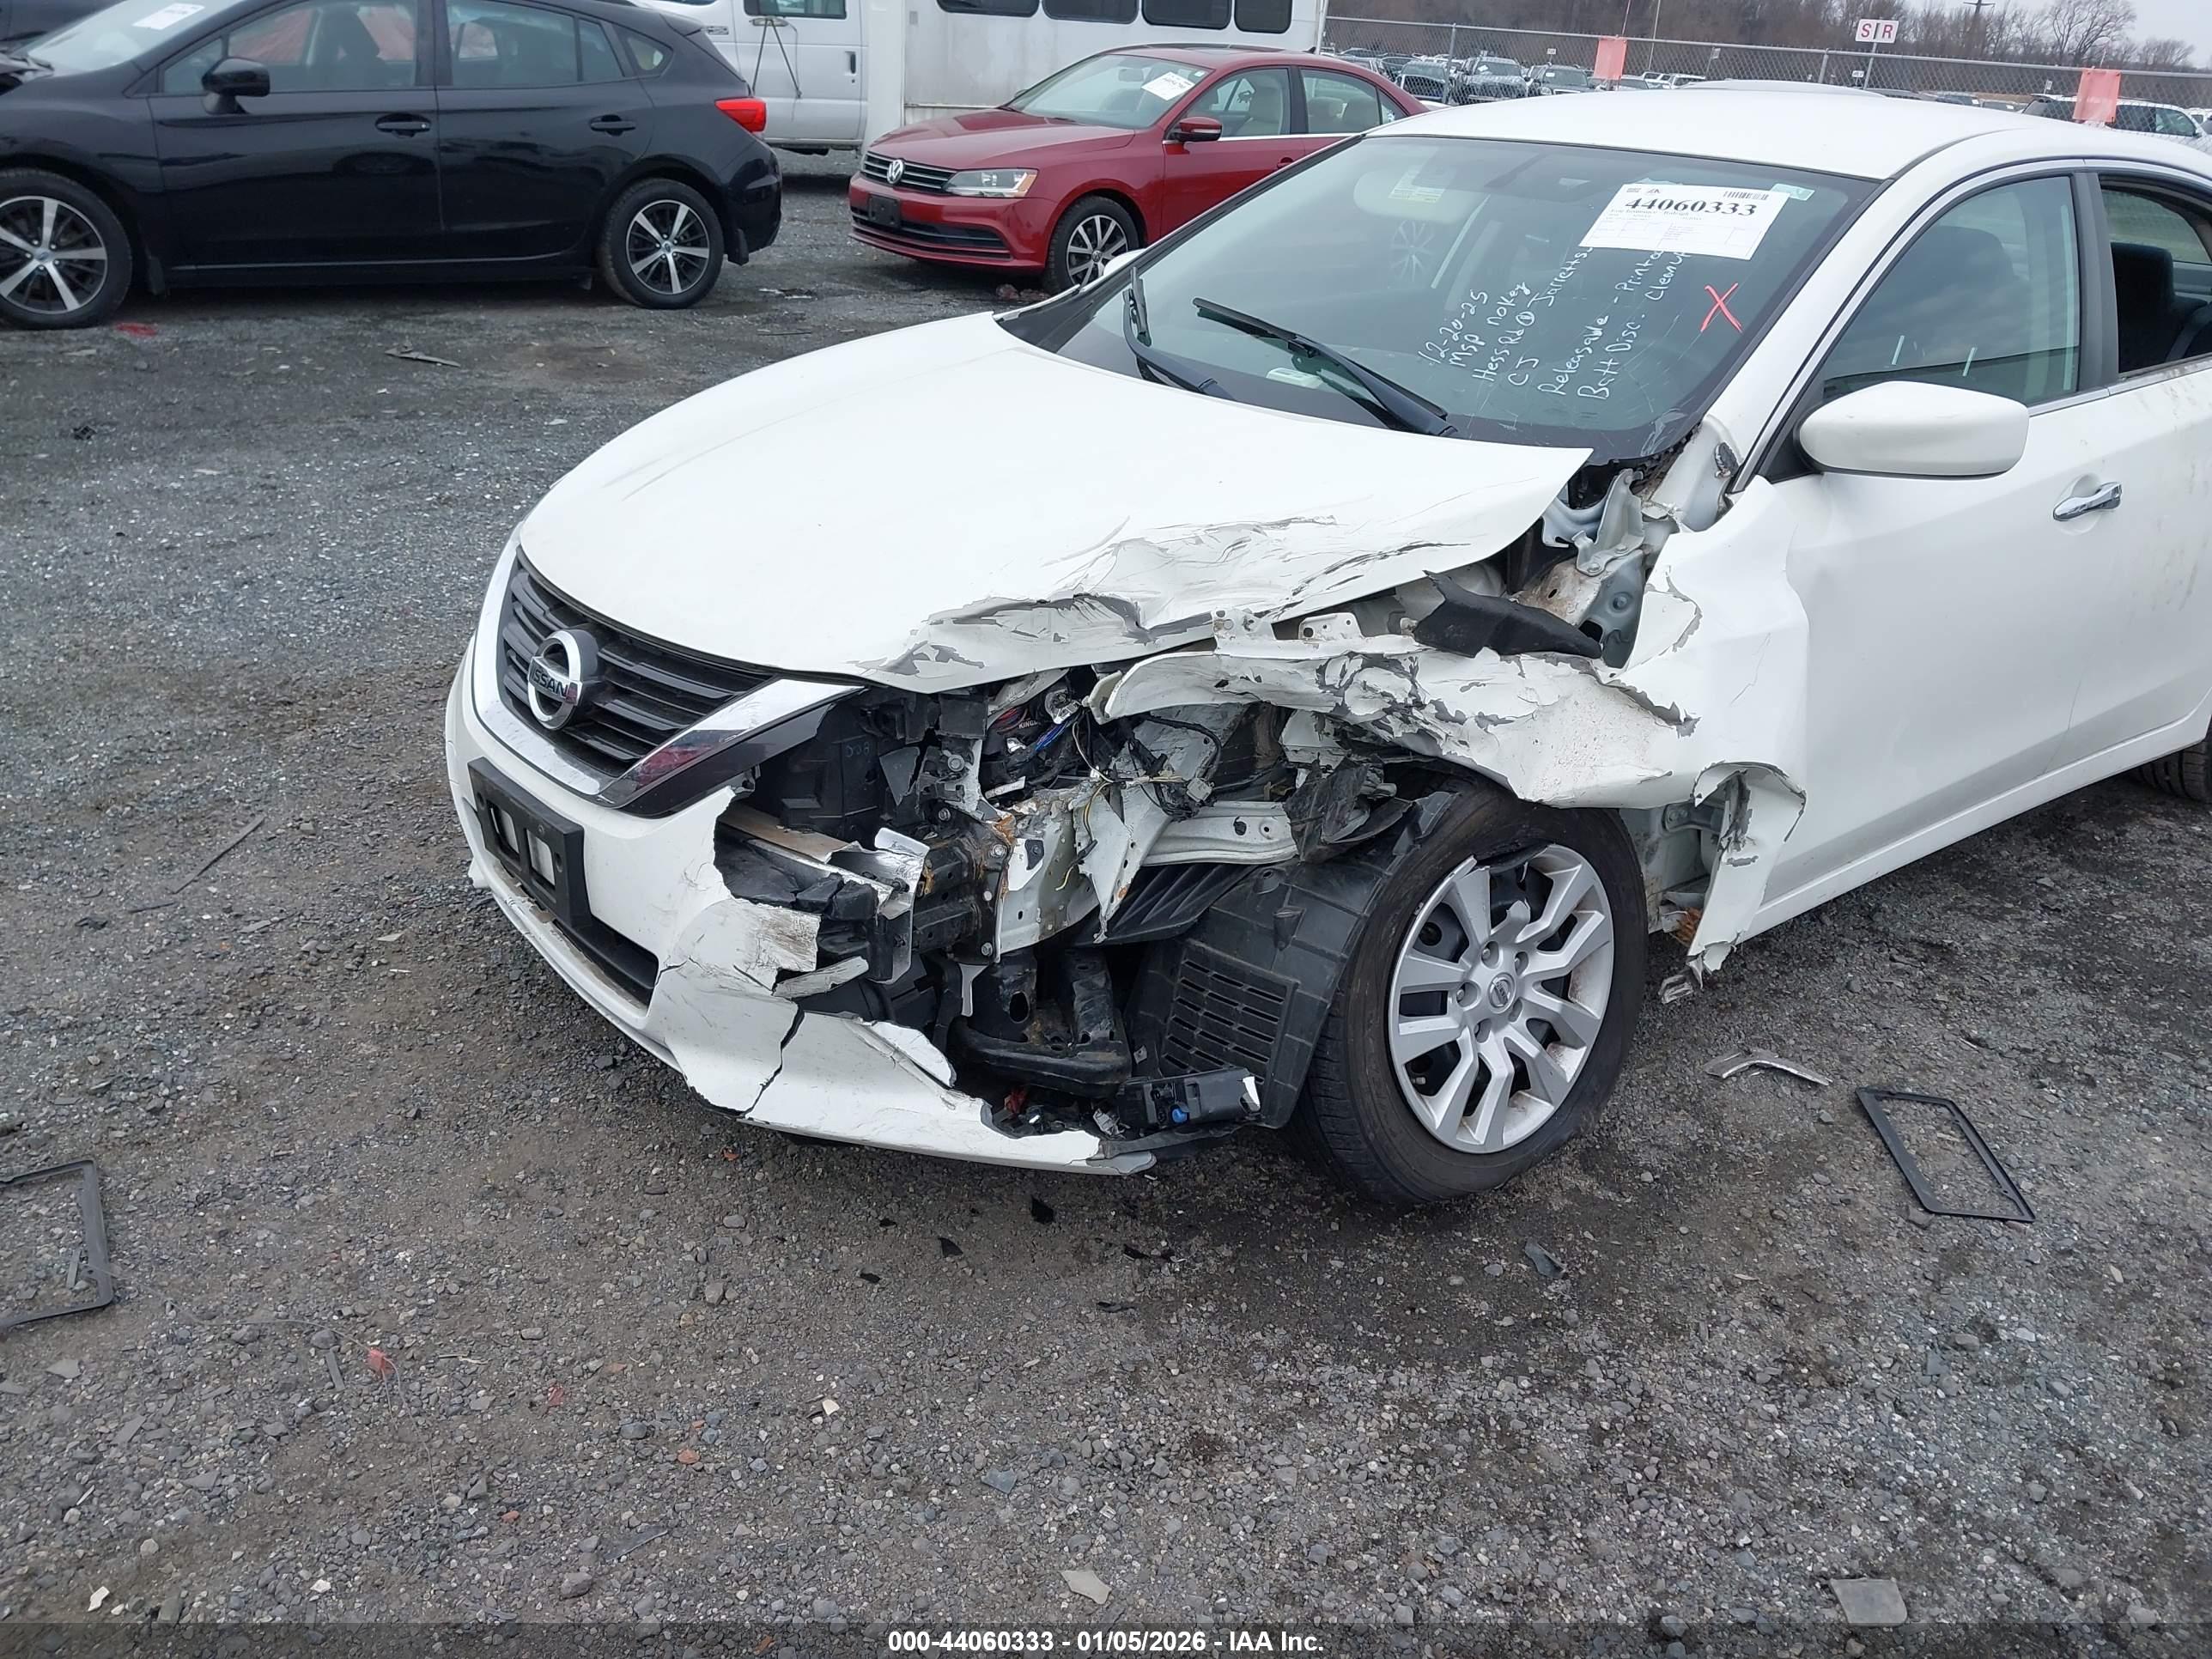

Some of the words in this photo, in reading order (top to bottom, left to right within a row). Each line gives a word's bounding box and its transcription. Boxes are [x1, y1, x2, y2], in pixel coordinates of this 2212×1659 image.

[1625, 198, 1757, 216] 44060333
[1418, 289, 1488, 364] 12-20-25
[1472, 348, 1510, 382] Hess
